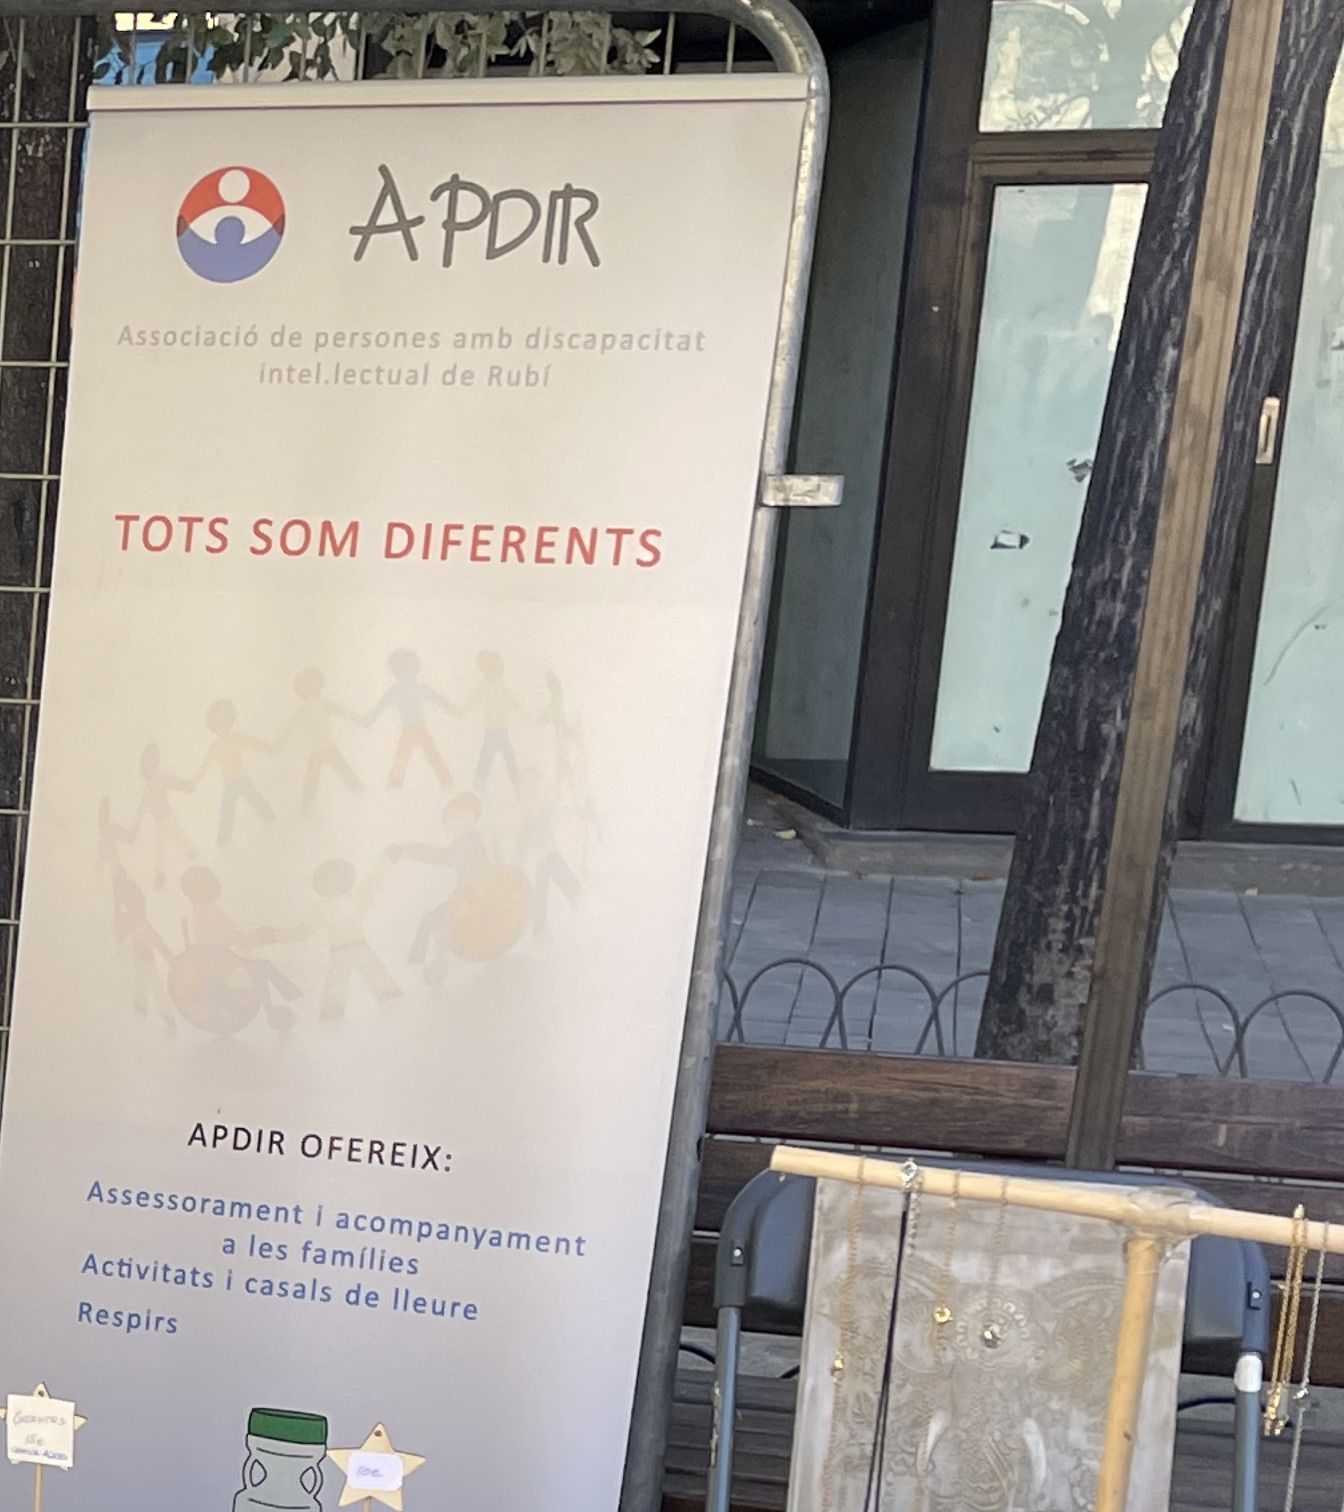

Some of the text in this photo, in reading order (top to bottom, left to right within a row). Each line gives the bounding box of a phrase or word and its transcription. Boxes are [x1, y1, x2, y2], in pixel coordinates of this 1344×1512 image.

[350, 163, 601, 267] APDIR
[118, 323, 705, 354] Associació de persones amb discapacitat
[259, 360, 550, 388] intel.lectual de Rubí
[115, 515, 664, 567] TOTS SOM DIFERENTS
[188, 1122, 452, 1172] APDIR OFEREIX:
[87, 1180, 587, 1258] Assessorament i acompanyament
[223, 1232, 420, 1276] a les famílies
[82, 1251, 480, 1321] Activitats i casals de lleure
[78, 1301, 179, 1338] Respirs
